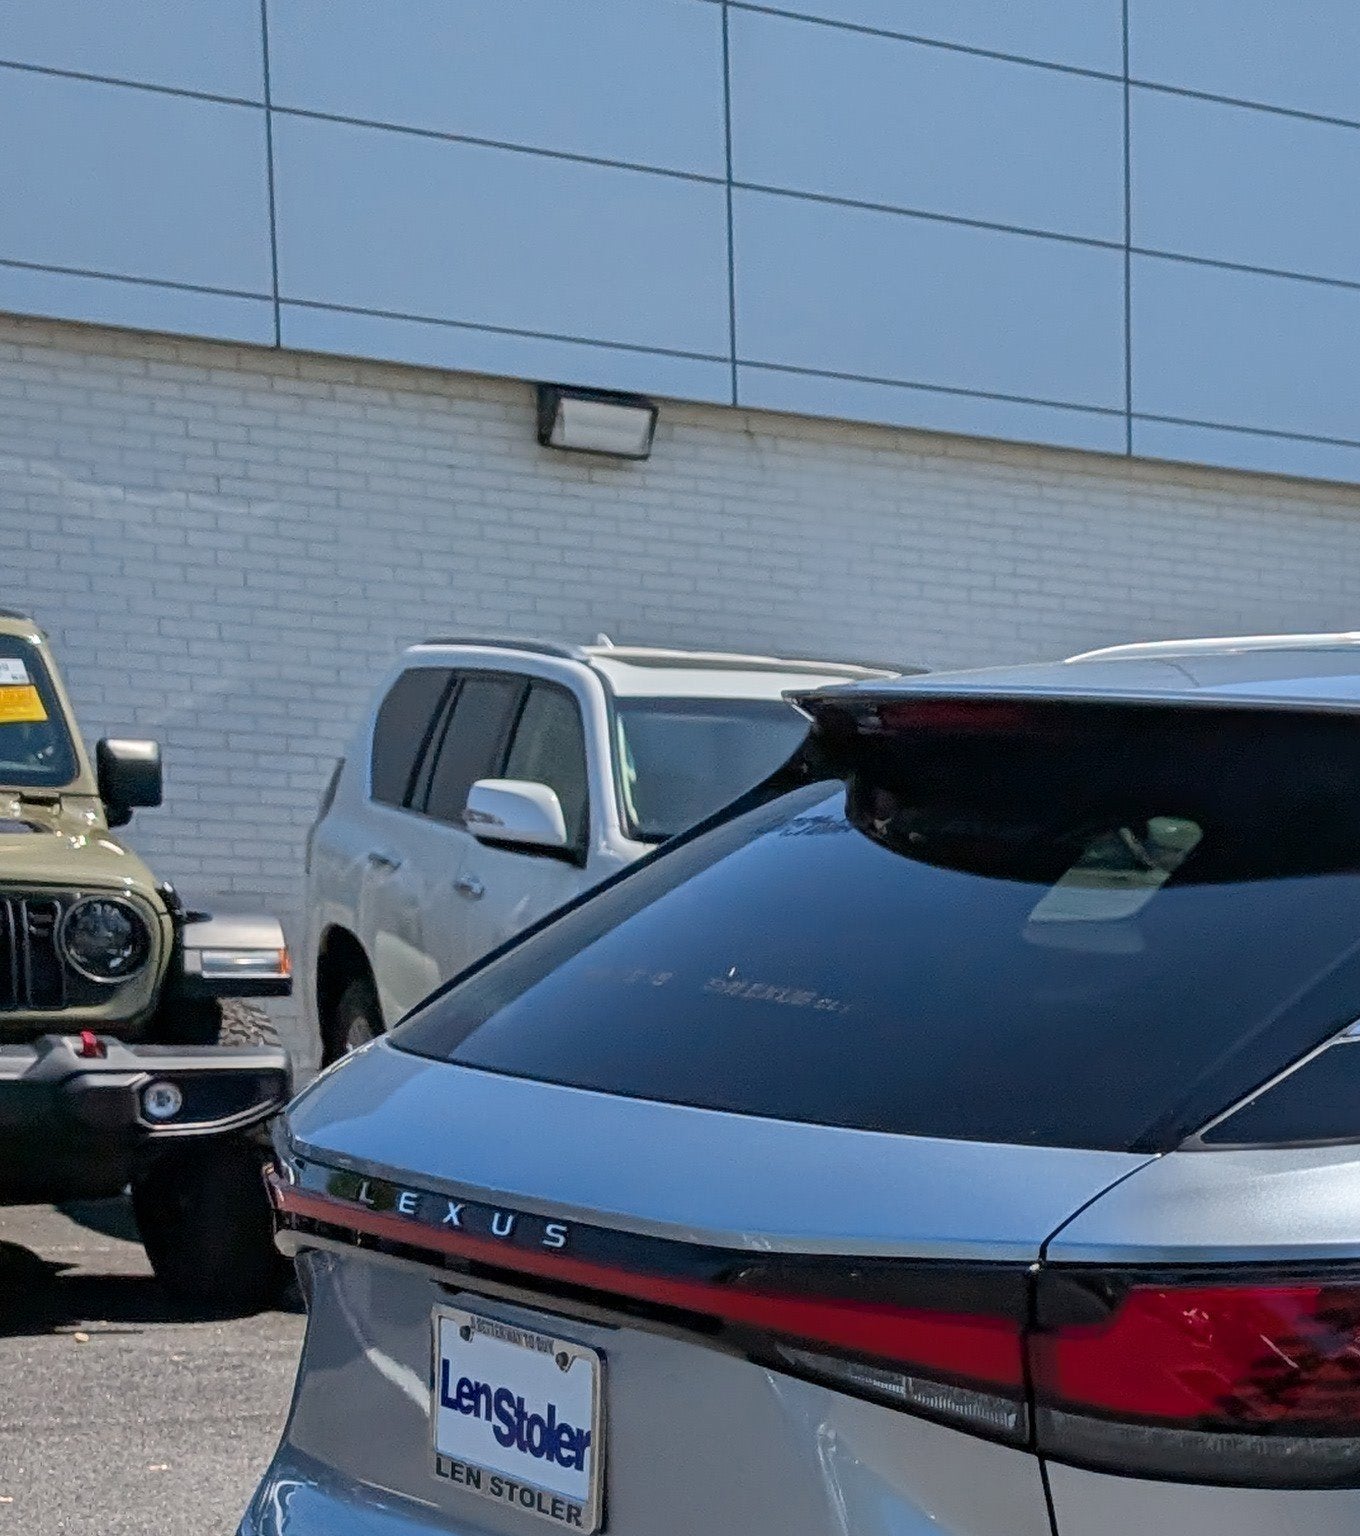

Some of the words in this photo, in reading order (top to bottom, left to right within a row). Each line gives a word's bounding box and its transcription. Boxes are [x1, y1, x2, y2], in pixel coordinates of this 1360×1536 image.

[358, 1181, 568, 1248] LEXUS
[435, 1456, 481, 1489] LEN
[489, 1476, 583, 1527] STOLER
